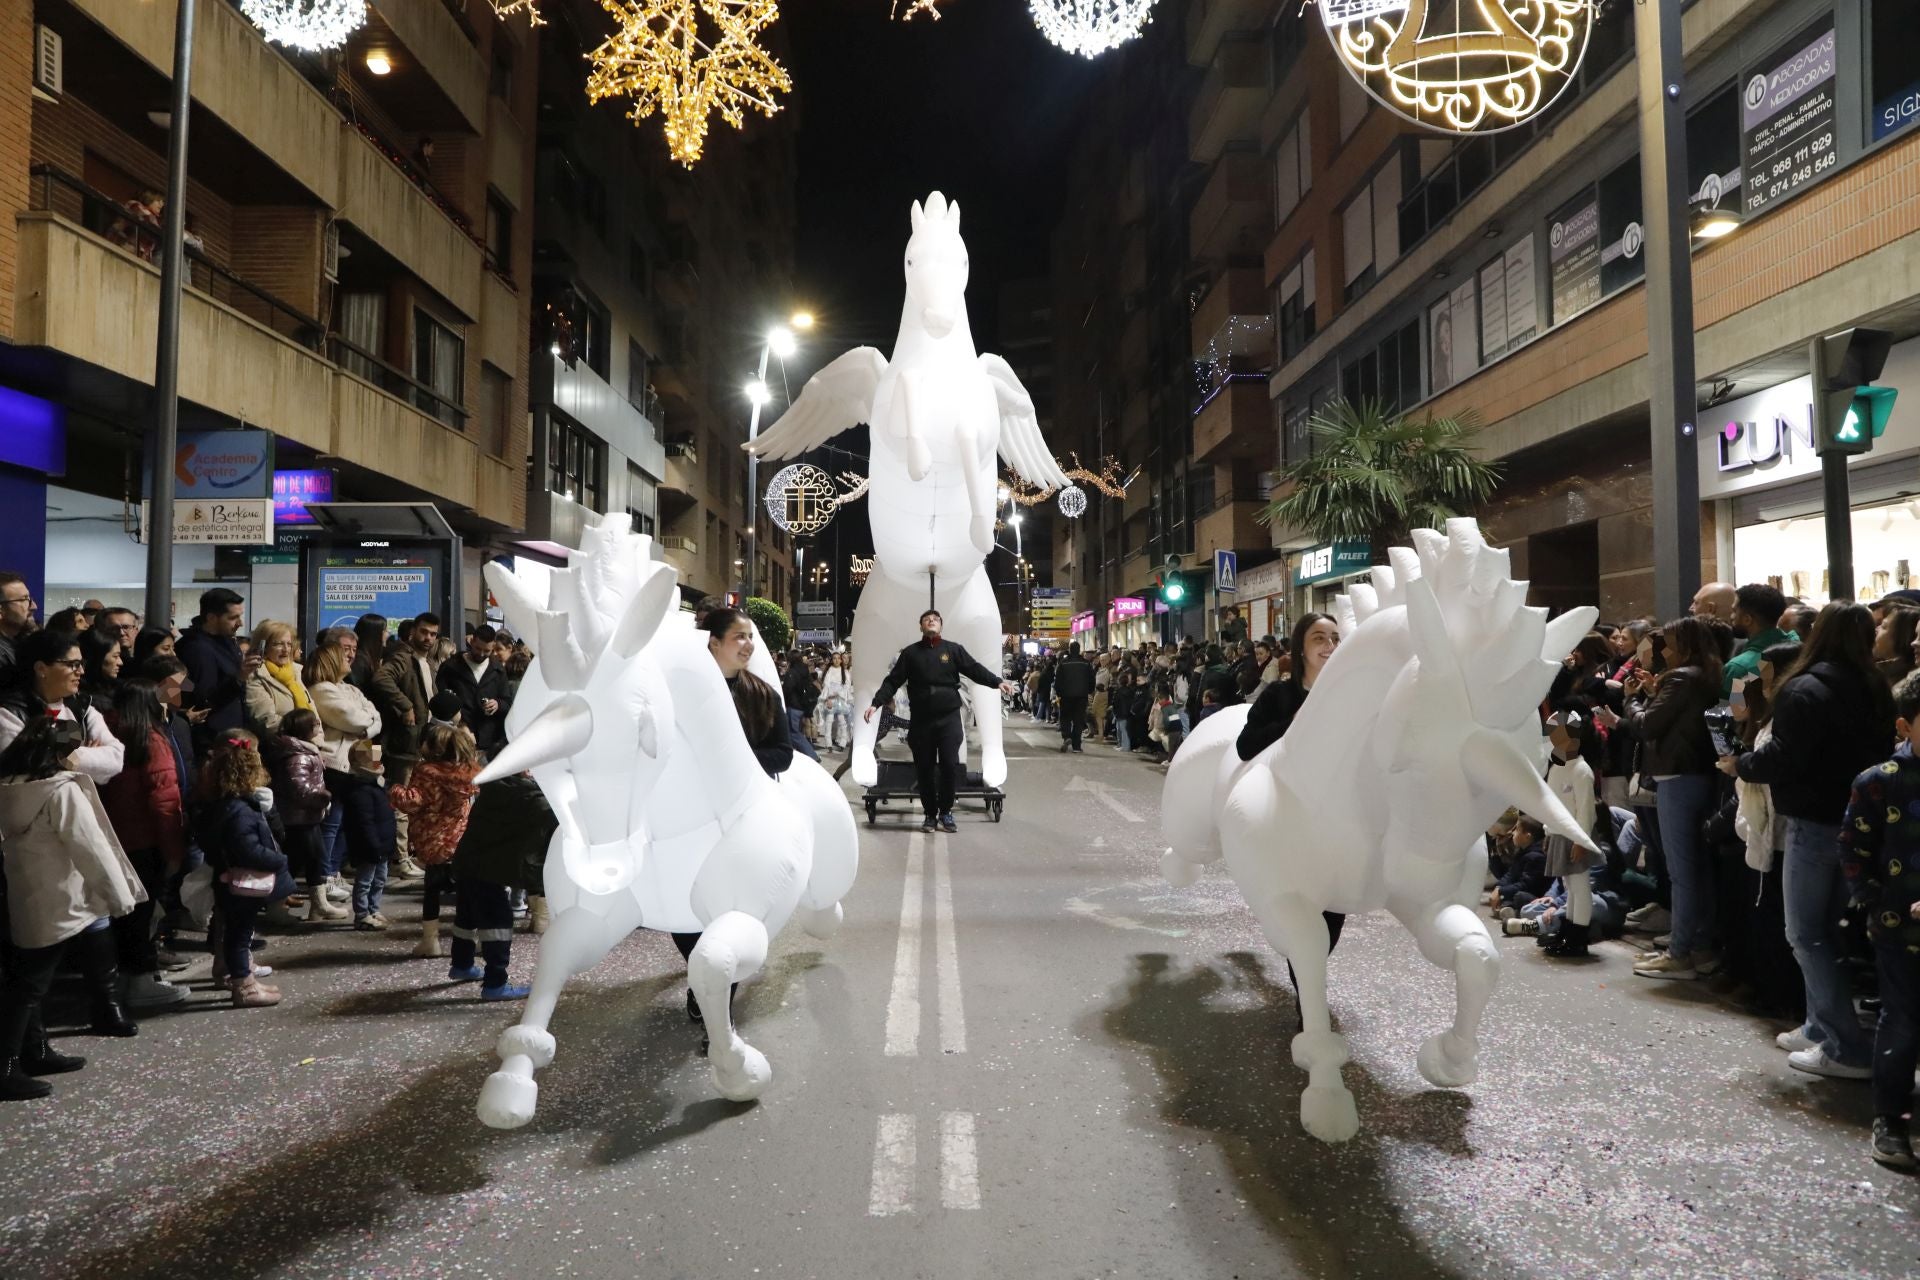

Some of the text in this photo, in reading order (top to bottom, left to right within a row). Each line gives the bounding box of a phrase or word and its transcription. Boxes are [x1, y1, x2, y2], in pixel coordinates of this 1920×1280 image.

[1770, 37, 1834, 90] ABOGADAS
[1770, 60, 1831, 109] MEDIADORAS
[1755, 92, 1826, 143] CIVIL PENAL FAMILIA
[1778, 98, 1833, 138] ADMINISTRATIVO
[1772, 156, 1792, 177] 968
[1794, 146, 1809, 164] 111
[1811, 132, 1832, 154] 929
[1770, 178, 1789, 198] 674
[1791, 165, 1812, 187] 243
[1814, 151, 1836, 173] 546
[1587, 274, 1600, 289] 929
[193, 453, 257, 465] Academia
[193, 466, 238, 478] Centro
[289, 475, 301, 494] DE
[303, 475, 330, 493] DANZA
[211, 504, 260, 524] Berkana
[177, 524, 191, 532] de
[229, 524, 264, 535] integral
[1300, 546, 1333, 580] ATLEET
[1337, 552, 1369, 560] ATLEET
